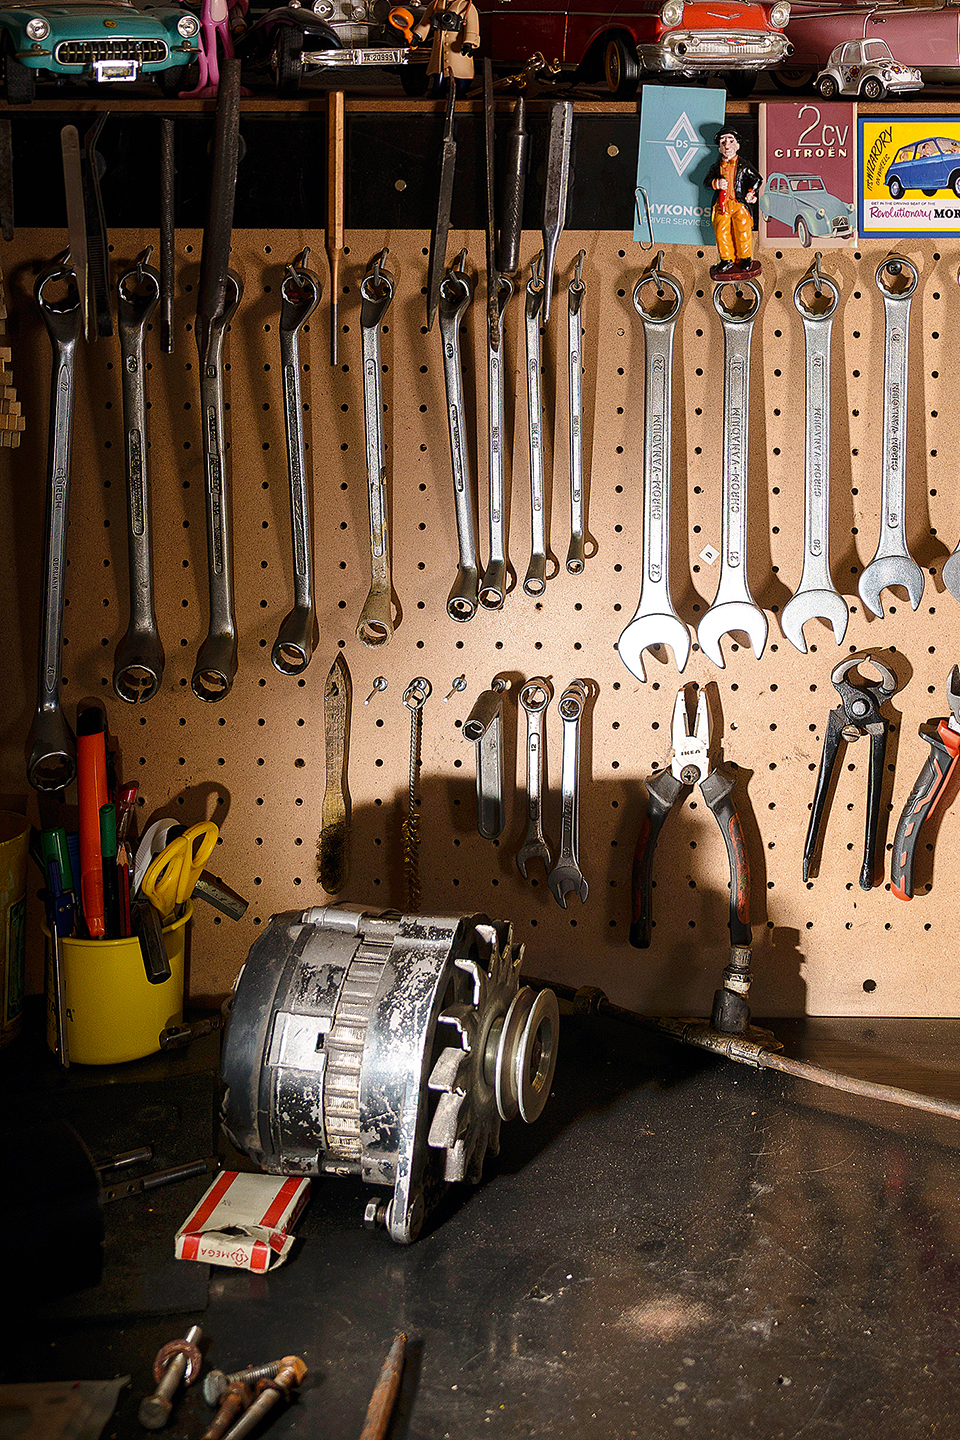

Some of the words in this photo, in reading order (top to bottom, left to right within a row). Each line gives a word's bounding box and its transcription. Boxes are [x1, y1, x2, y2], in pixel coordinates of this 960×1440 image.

[675, 138, 689, 148] DS
[773, 146, 848, 159] CITROËN
[866, 125, 893, 181] WIZARDRY
[643, 203, 712, 218] MYKONOS
[869, 206, 932, 221] Revolutionary
[673, 216, 711, 228] SERVICES
[651, 358, 663, 373] 22
[732, 360, 742, 372] 21
[730, 406, 742, 514] CHROM-VANADIUM
[813, 407, 823, 498] CHROM-VANADIUM
[651, 413, 663, 521] CHROM-VANADIUM
[730, 550, 740, 562] 21
[52, 557, 60, 591] GERMANY
[650, 563, 661, 578] 22
[531, 743, 537, 752] 12
